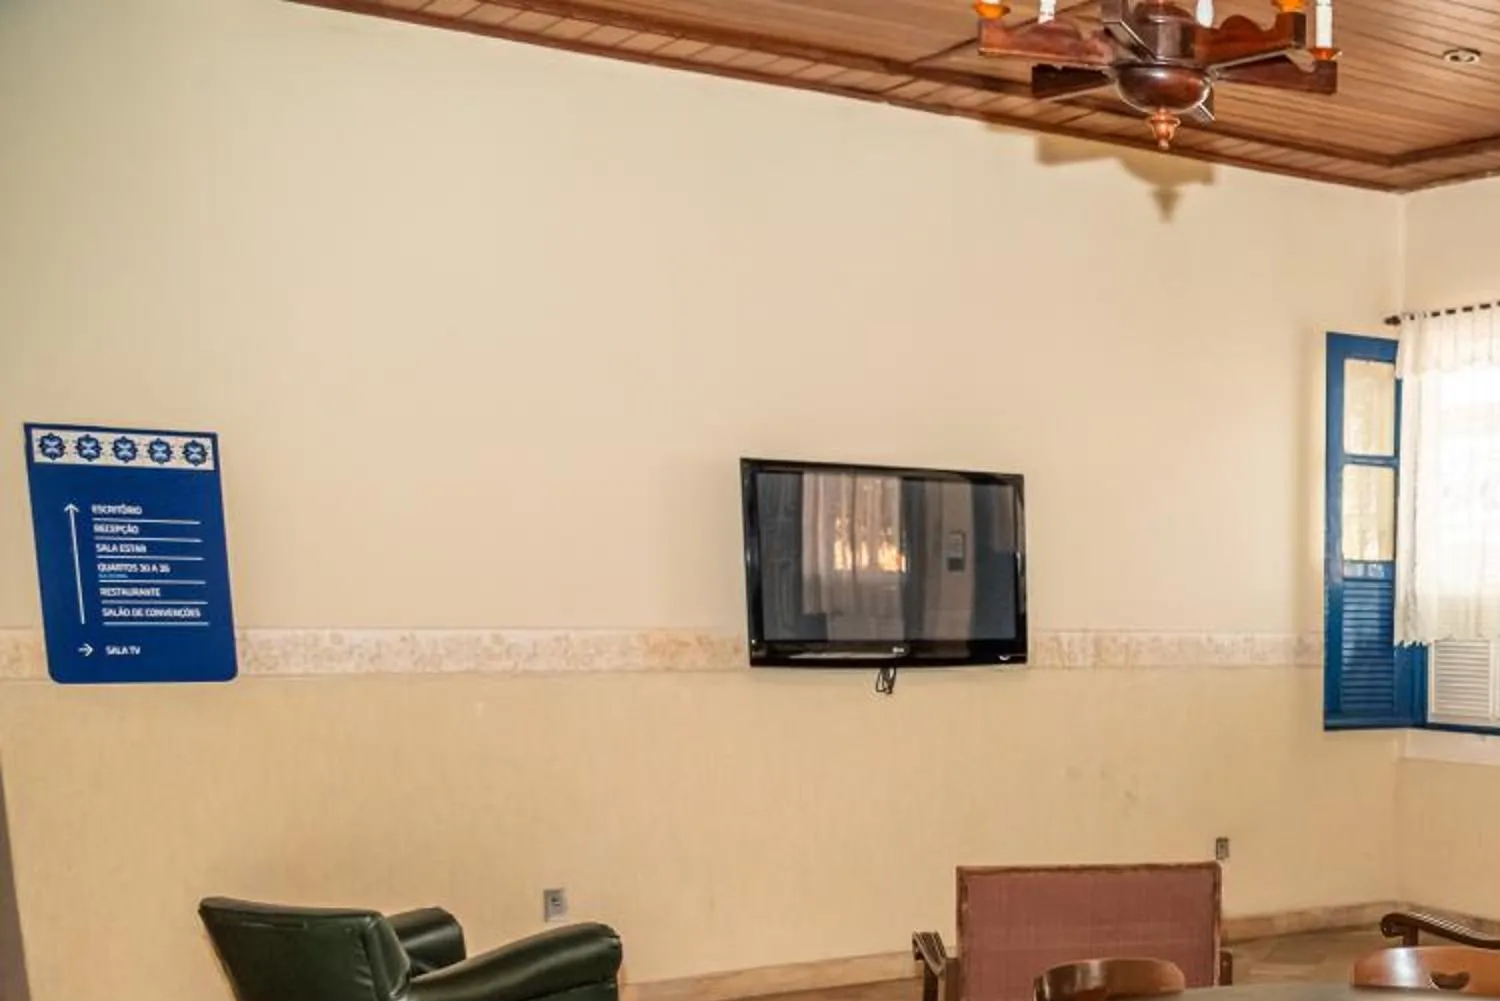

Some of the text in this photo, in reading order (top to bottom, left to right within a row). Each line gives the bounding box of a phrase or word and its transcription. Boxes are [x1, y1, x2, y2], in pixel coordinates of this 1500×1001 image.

[95, 543, 147, 553] SALA ESTAR
[97, 563, 138, 573] QUARTOS
[99, 587, 161, 597] RESTAURANTE
[102, 606, 131, 617] SALÃO
[132, 607, 144, 617] DE
[105, 645, 141, 655] SALA TV
